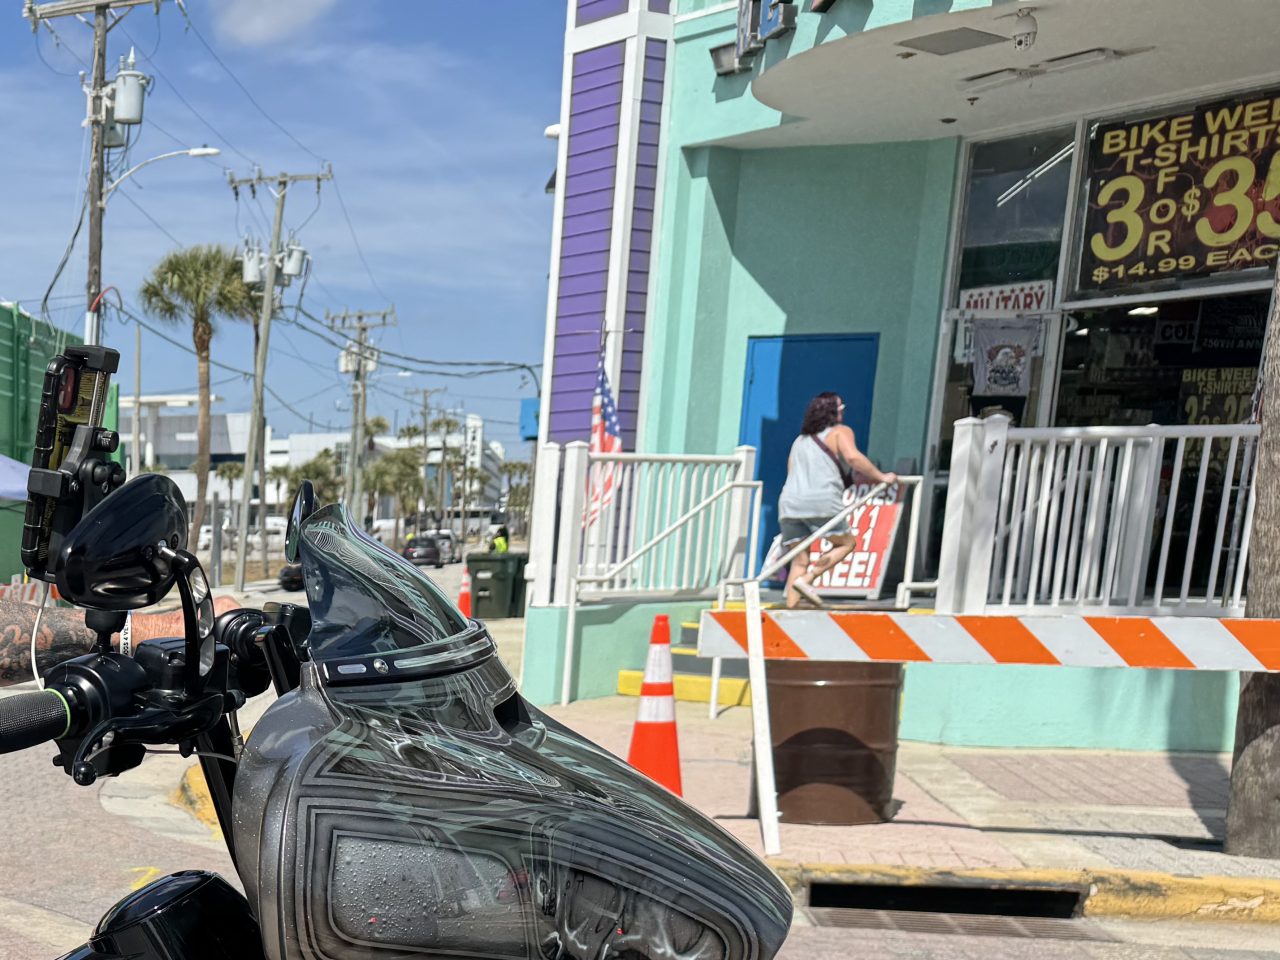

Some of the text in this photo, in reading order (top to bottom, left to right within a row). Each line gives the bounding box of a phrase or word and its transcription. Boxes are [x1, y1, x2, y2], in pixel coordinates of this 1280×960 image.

[1102, 115, 1194, 154] BIKE
[1120, 123, 1280, 173] T-SHIRT
[1091, 175, 1145, 261] 3
[1092, 244, 1280, 284] $14.99 EAC
[1182, 368, 1217, 383] BIKE
